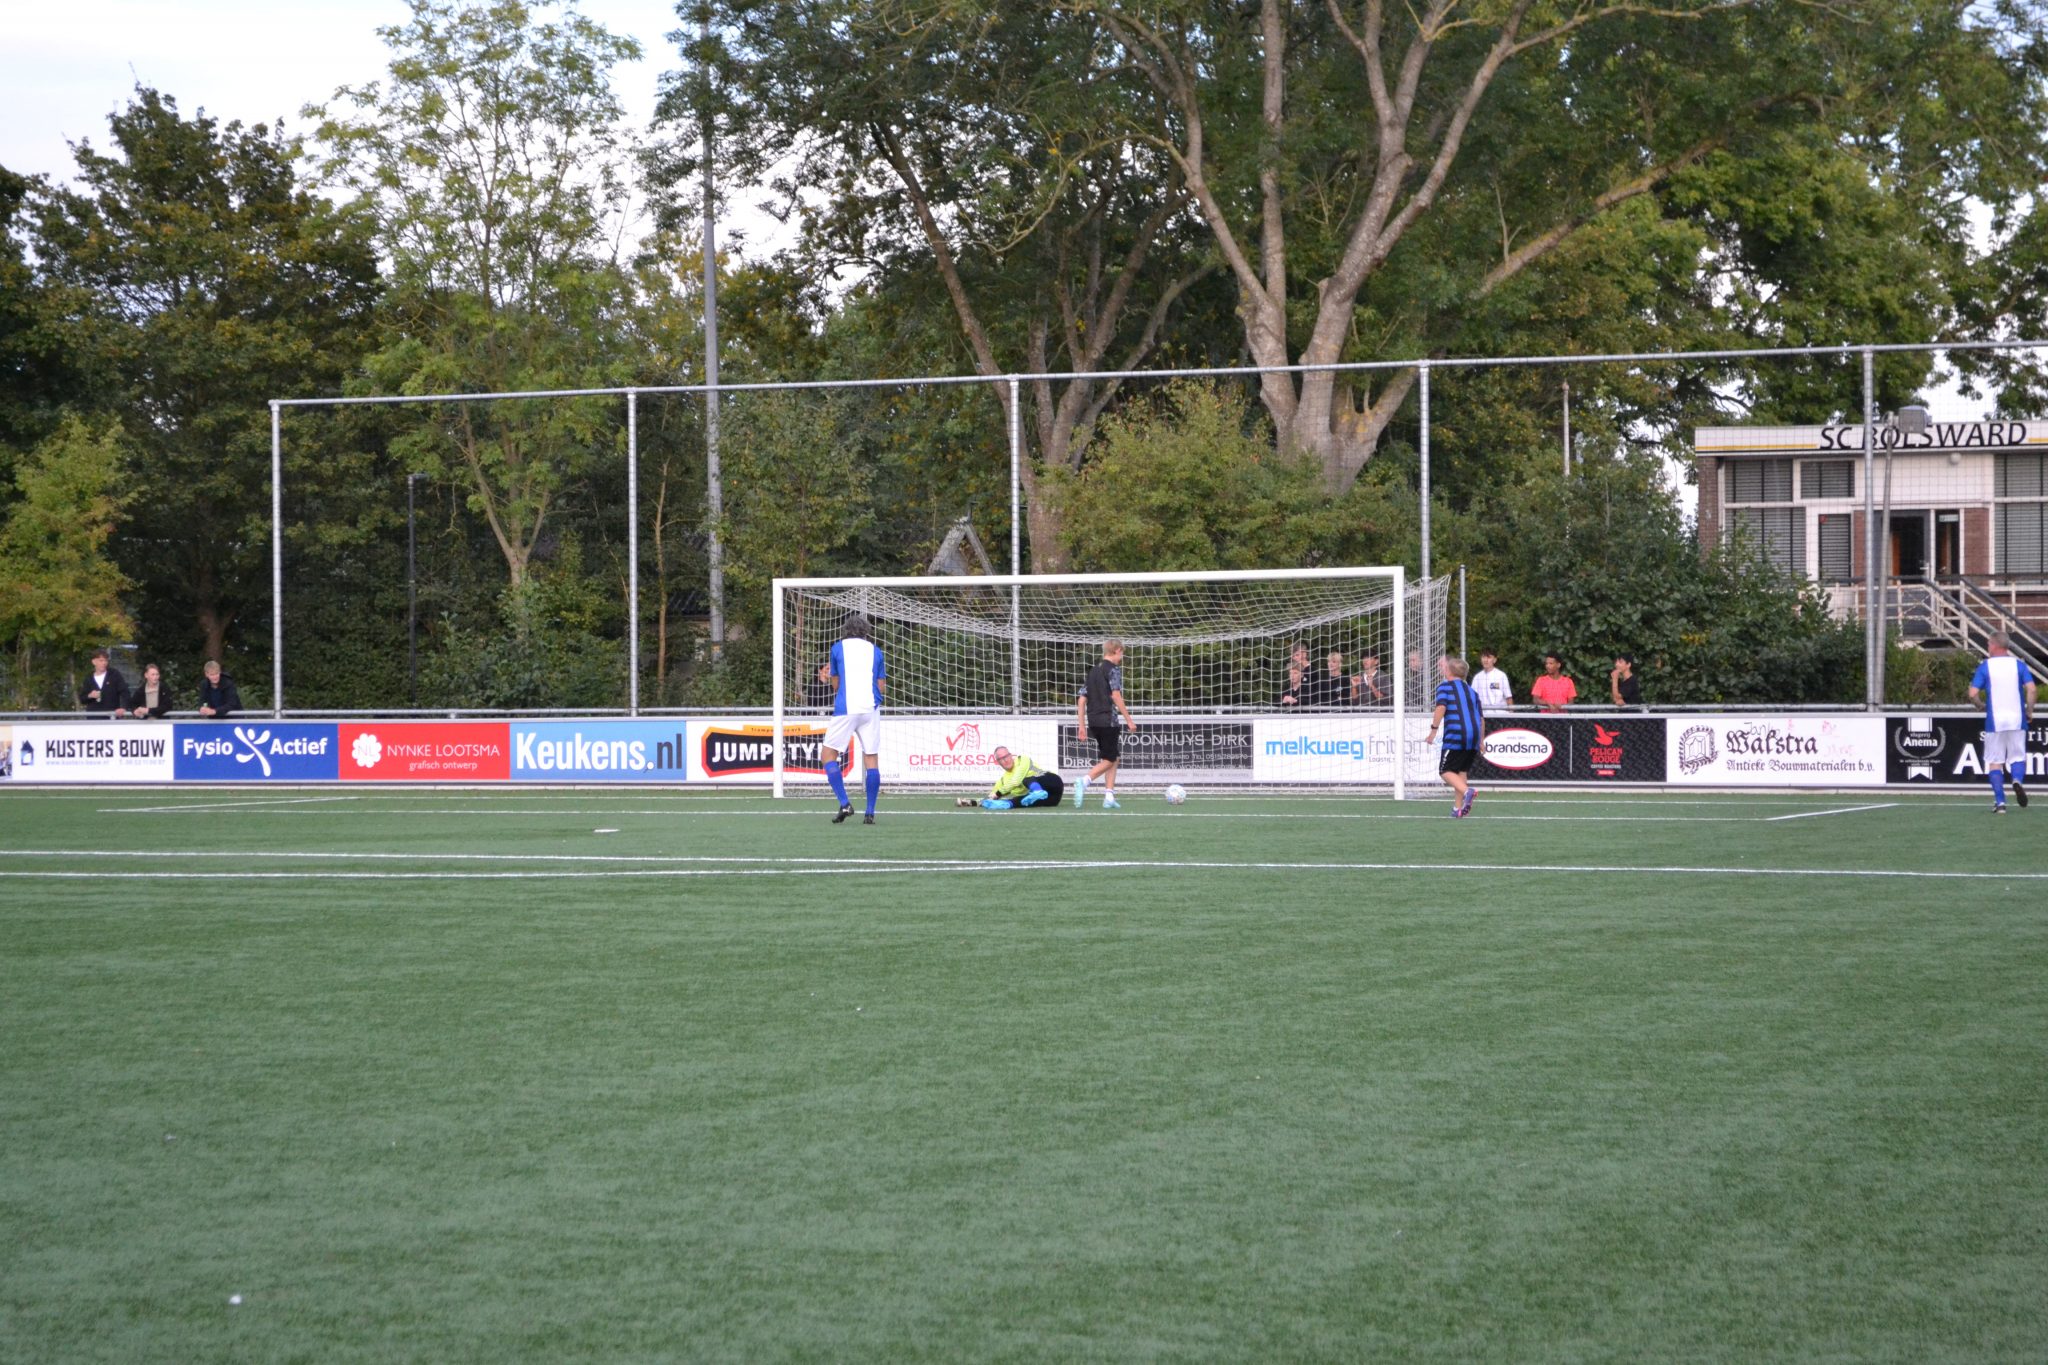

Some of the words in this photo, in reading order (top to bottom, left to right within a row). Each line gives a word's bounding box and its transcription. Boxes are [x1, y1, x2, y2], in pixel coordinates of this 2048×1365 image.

[1820, 427, 1852, 449] SC
[1118, 734, 1204, 746] WOONHUYS
[1212, 734, 1248, 746] DIRK
[1903, 737, 1939, 747] Anema
[1980, 727, 2048, 746] srij
[46, 739, 114, 758] KUSTERS
[119, 739, 165, 758] BOUW
[183, 738, 233, 759] Fysio
[269, 737, 328, 755] Actief
[387, 745, 432, 757] NYNKE
[435, 745, 500, 757] LOOTSMA
[516, 732, 682, 771] Keukens.nl
[1266, 736, 1364, 760] melkweg
[1486, 742, 1548, 754] brandsma
[409, 759, 440, 771] grafisch
[442, 762, 478, 771] ontwerp
[909, 754, 1017, 766] CHECK&SA
[1592, 755, 1620, 763] ROUGE
[1768, 759, 1856, 772] Bouwmaterialen
